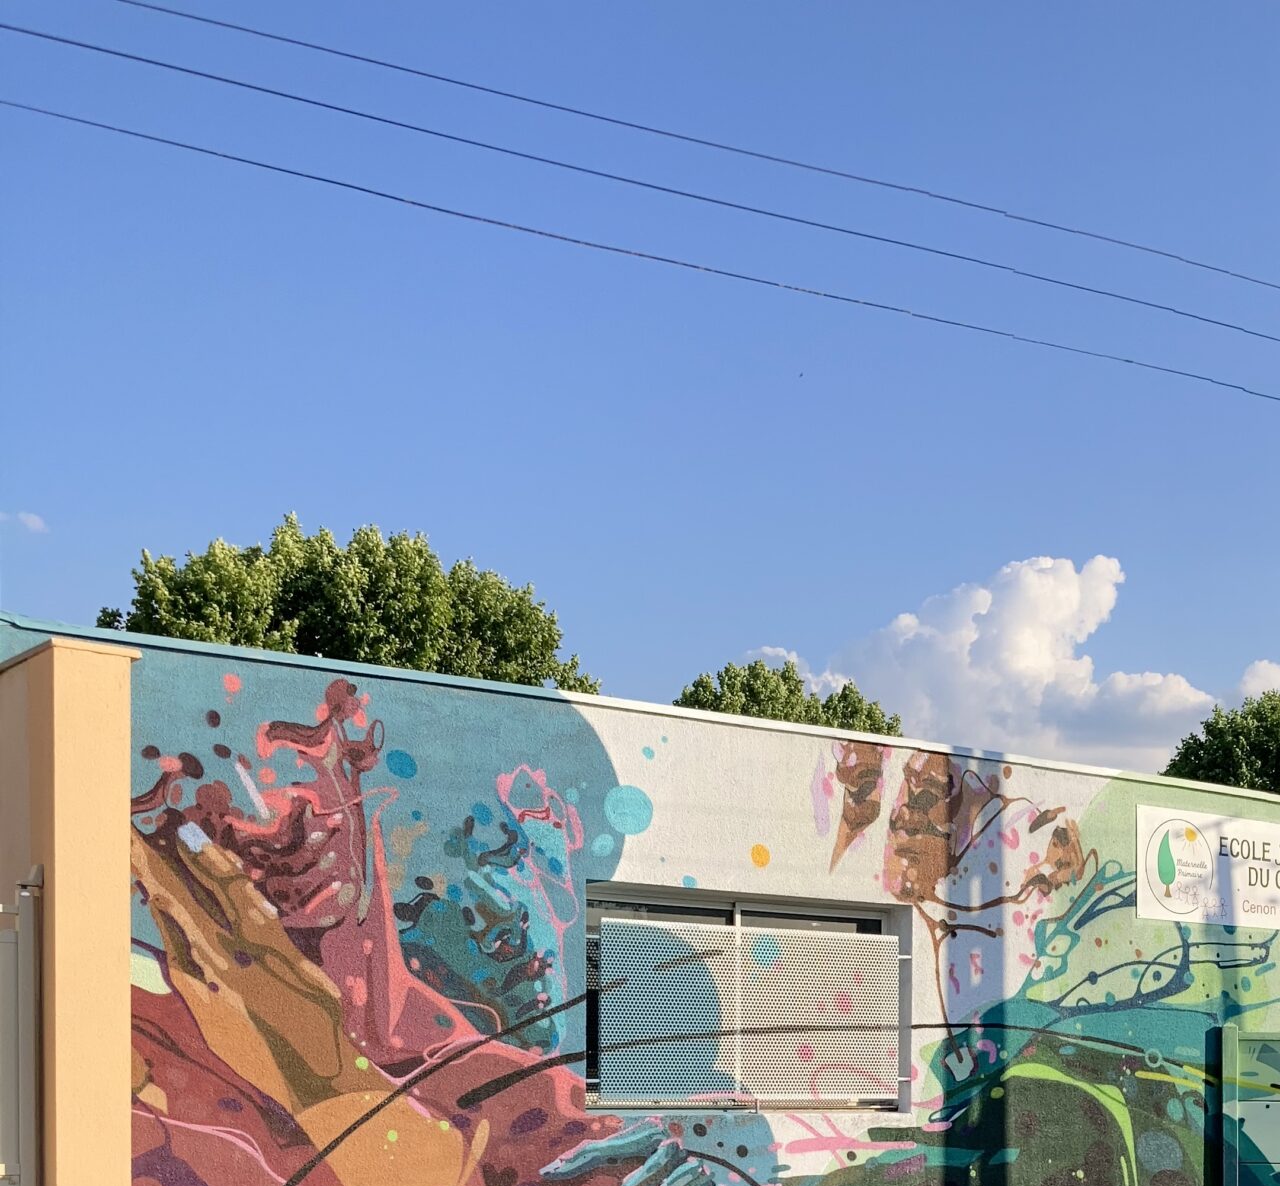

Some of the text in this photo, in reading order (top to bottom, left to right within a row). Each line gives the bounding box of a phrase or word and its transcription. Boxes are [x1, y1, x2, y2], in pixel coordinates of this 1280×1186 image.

[1218, 836, 1271, 862] ECOLE
[1248, 867, 1270, 888] DU
[1242, 900, 1276, 916] Cenon
